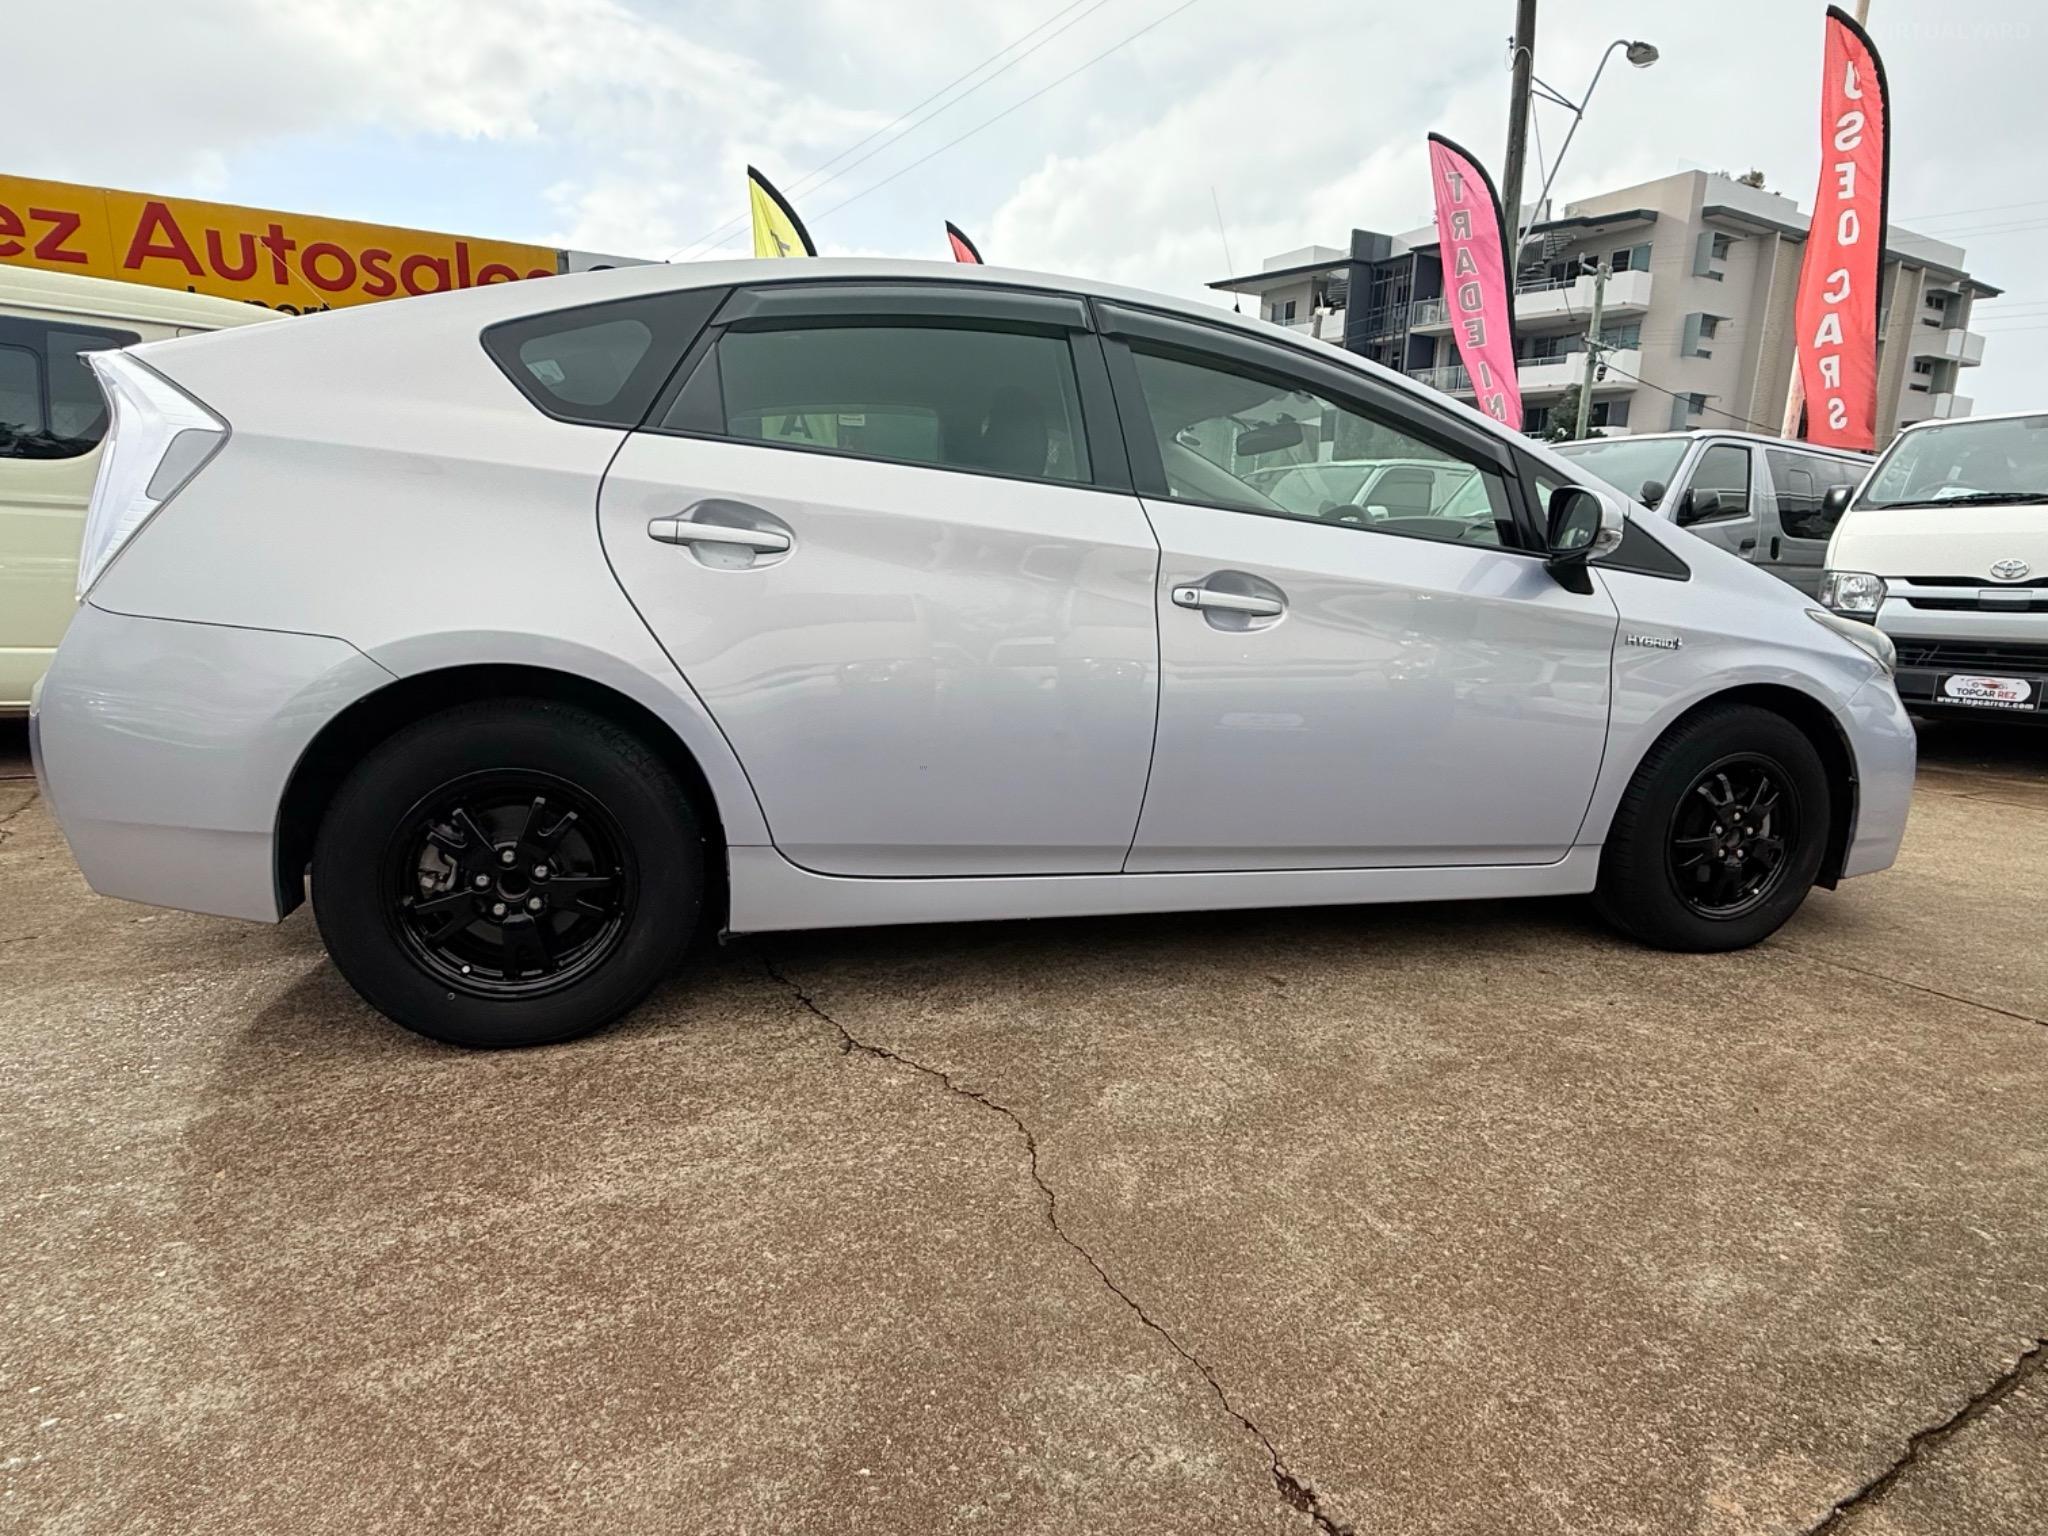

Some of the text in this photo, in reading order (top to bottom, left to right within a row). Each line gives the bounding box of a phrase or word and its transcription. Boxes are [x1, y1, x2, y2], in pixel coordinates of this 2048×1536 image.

[124, 201, 555, 297] Autosal
[1625, 634, 1676, 649] HYBRID
[1956, 687, 2017, 700] TOPCAR REZ
[1937, 696, 2034, 710] www.topcarrez.com
